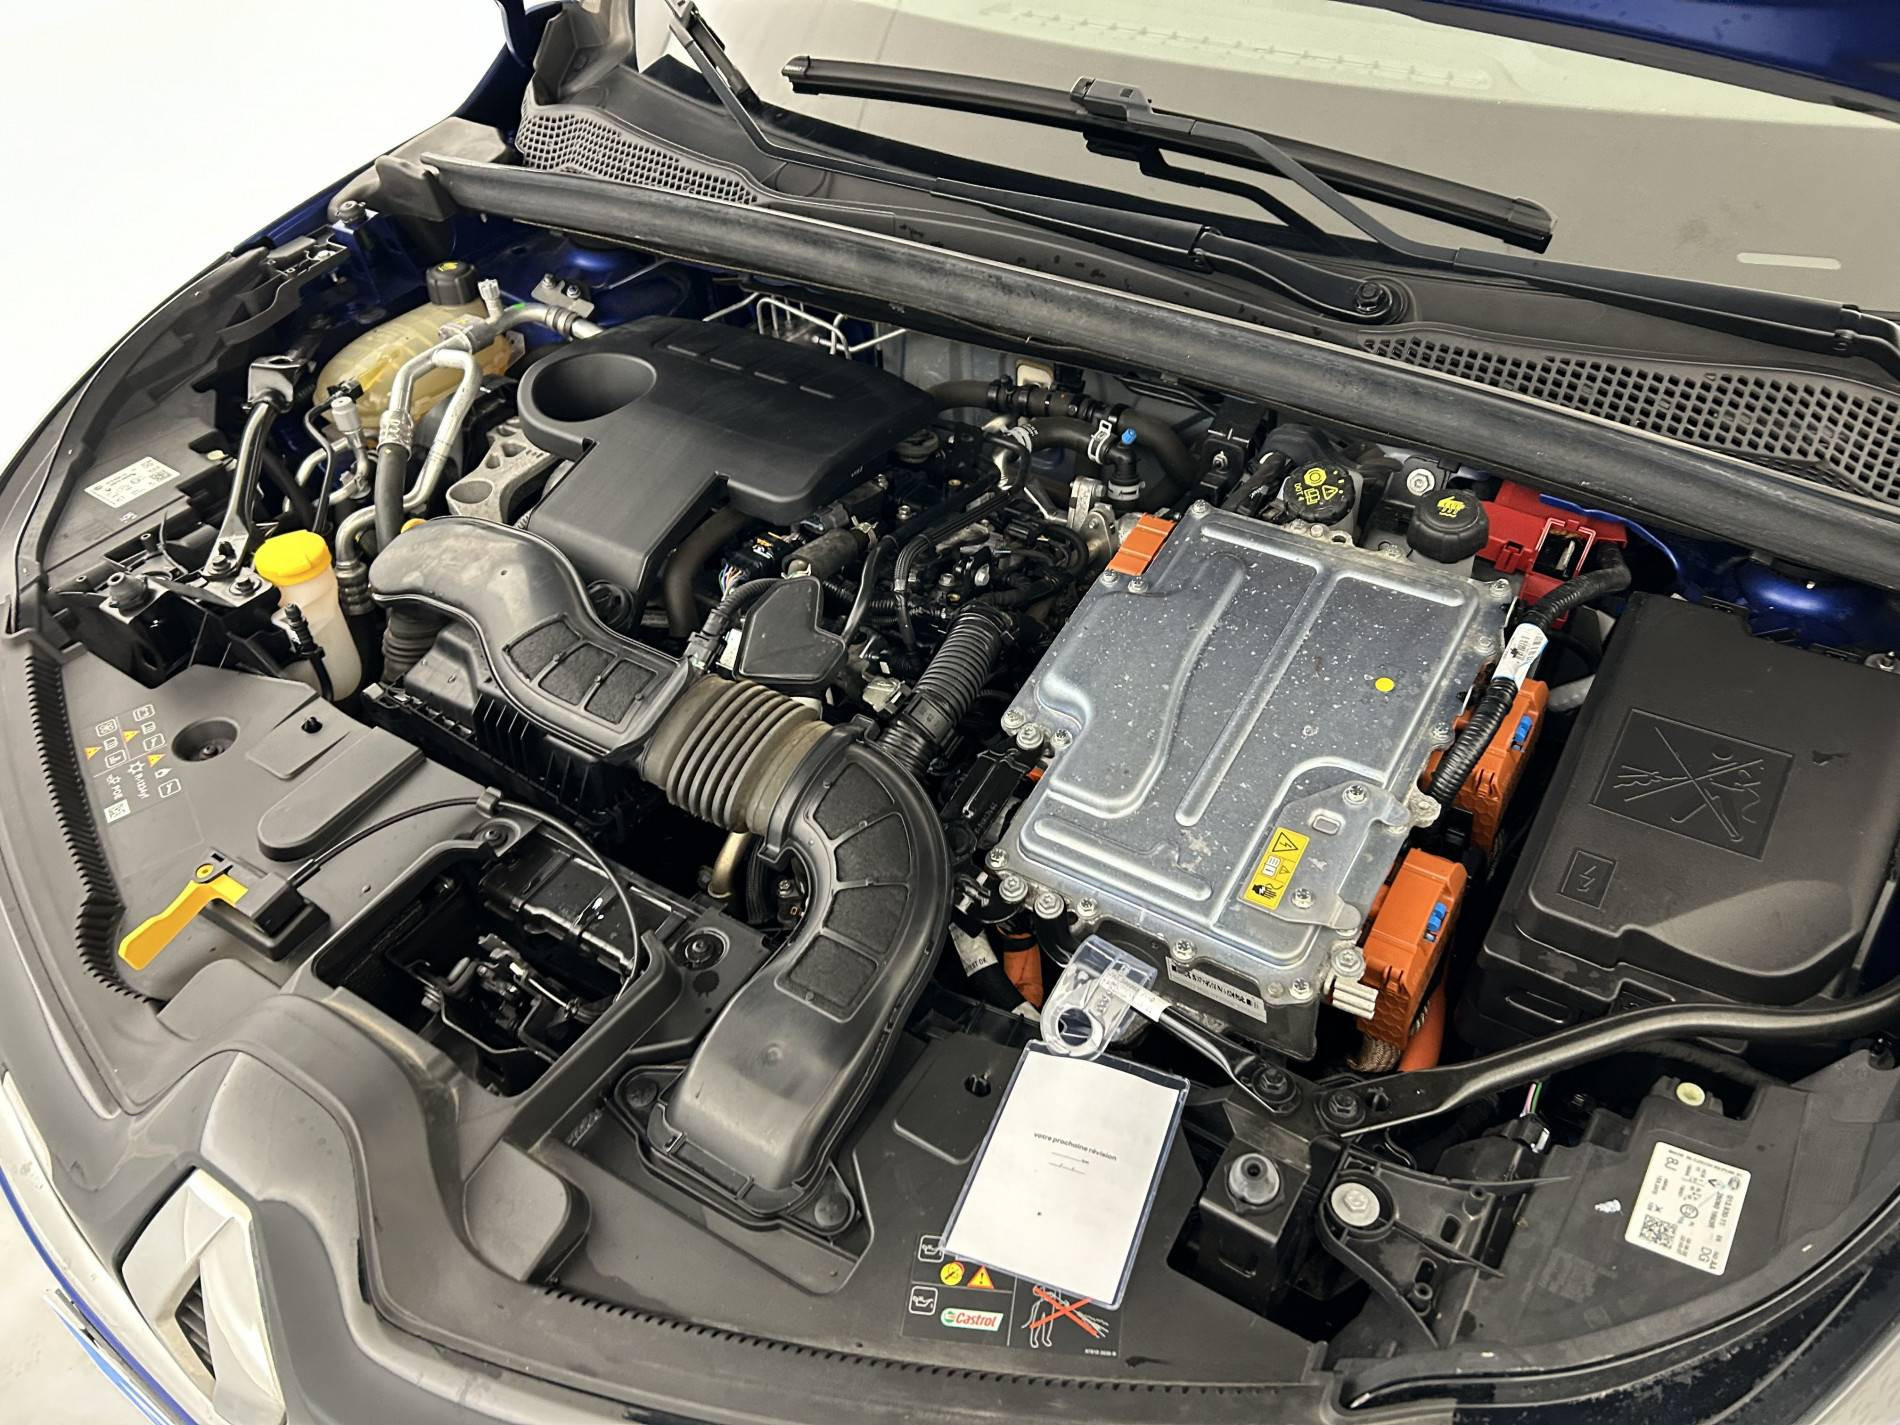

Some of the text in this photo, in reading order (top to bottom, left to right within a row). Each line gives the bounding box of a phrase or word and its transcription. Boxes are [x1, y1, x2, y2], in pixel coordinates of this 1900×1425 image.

[1294, 483, 1303, 496] DOT
[1034, 1133, 1117, 1161] votre prochaine révision
[1699, 1246, 1713, 1262] DG
[955, 1311, 997, 1328] Castrol
